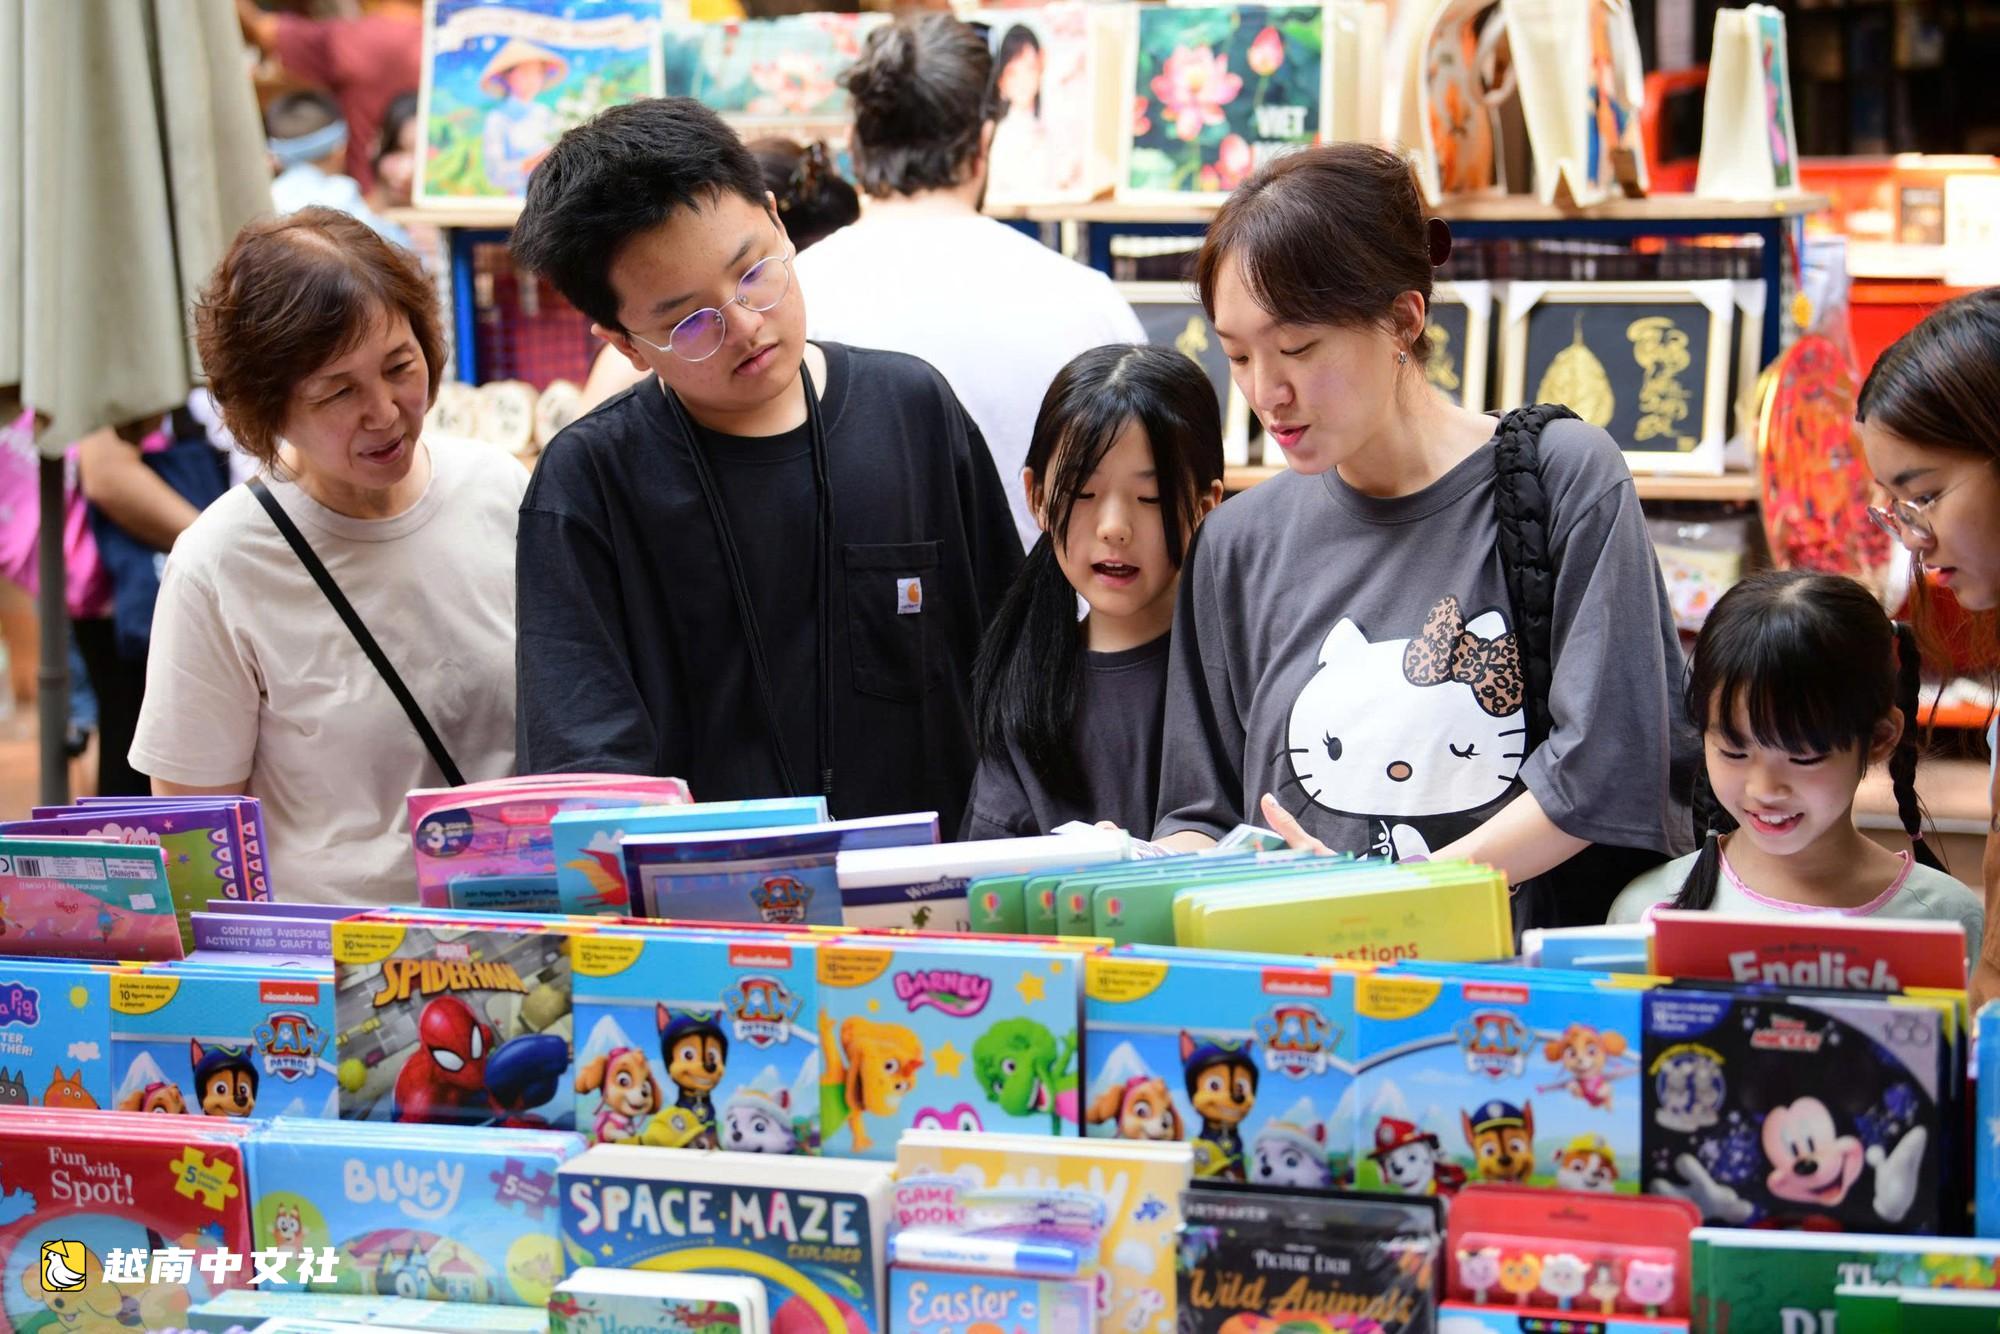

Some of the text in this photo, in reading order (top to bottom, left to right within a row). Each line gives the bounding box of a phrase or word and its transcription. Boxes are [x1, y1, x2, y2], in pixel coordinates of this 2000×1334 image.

[425, 821, 445, 849] 3
[205, 936, 250, 947] ACTIVITY
[255, 938, 277, 948] AND
[280, 939, 313, 949] CRAFT
[220, 926, 328, 939] CONTAINS AWESOME
[1304, 943, 1418, 962] estions
[1728, 950, 1899, 991] English
[373, 959, 529, 1008] SPIDER-MAN
[11, 989, 34, 1018] Pig
[120, 990, 130, 1000] 10
[722, 987, 802, 1020] PAW
[254, 1022, 329, 1054] PAW
[270, 1058, 309, 1068] PATROL
[48, 1146, 86, 1165] Fun
[83, 1163, 121, 1178] with
[185, 1165, 197, 1184] 5
[51, 1169, 135, 1207] Spot!
[504, 1175, 518, 1196] 5
[897, 1188, 955, 1204] GAME
[570, 1182, 715, 1237] SPACE
[731, 1189, 860, 1246] MAZE
[900, 1208, 966, 1226] BOOK!
[786, 1244, 862, 1264] EXPLORER
[907, 1280, 1018, 1327] Easter
[1190, 1267, 1413, 1324] Wild Animals
